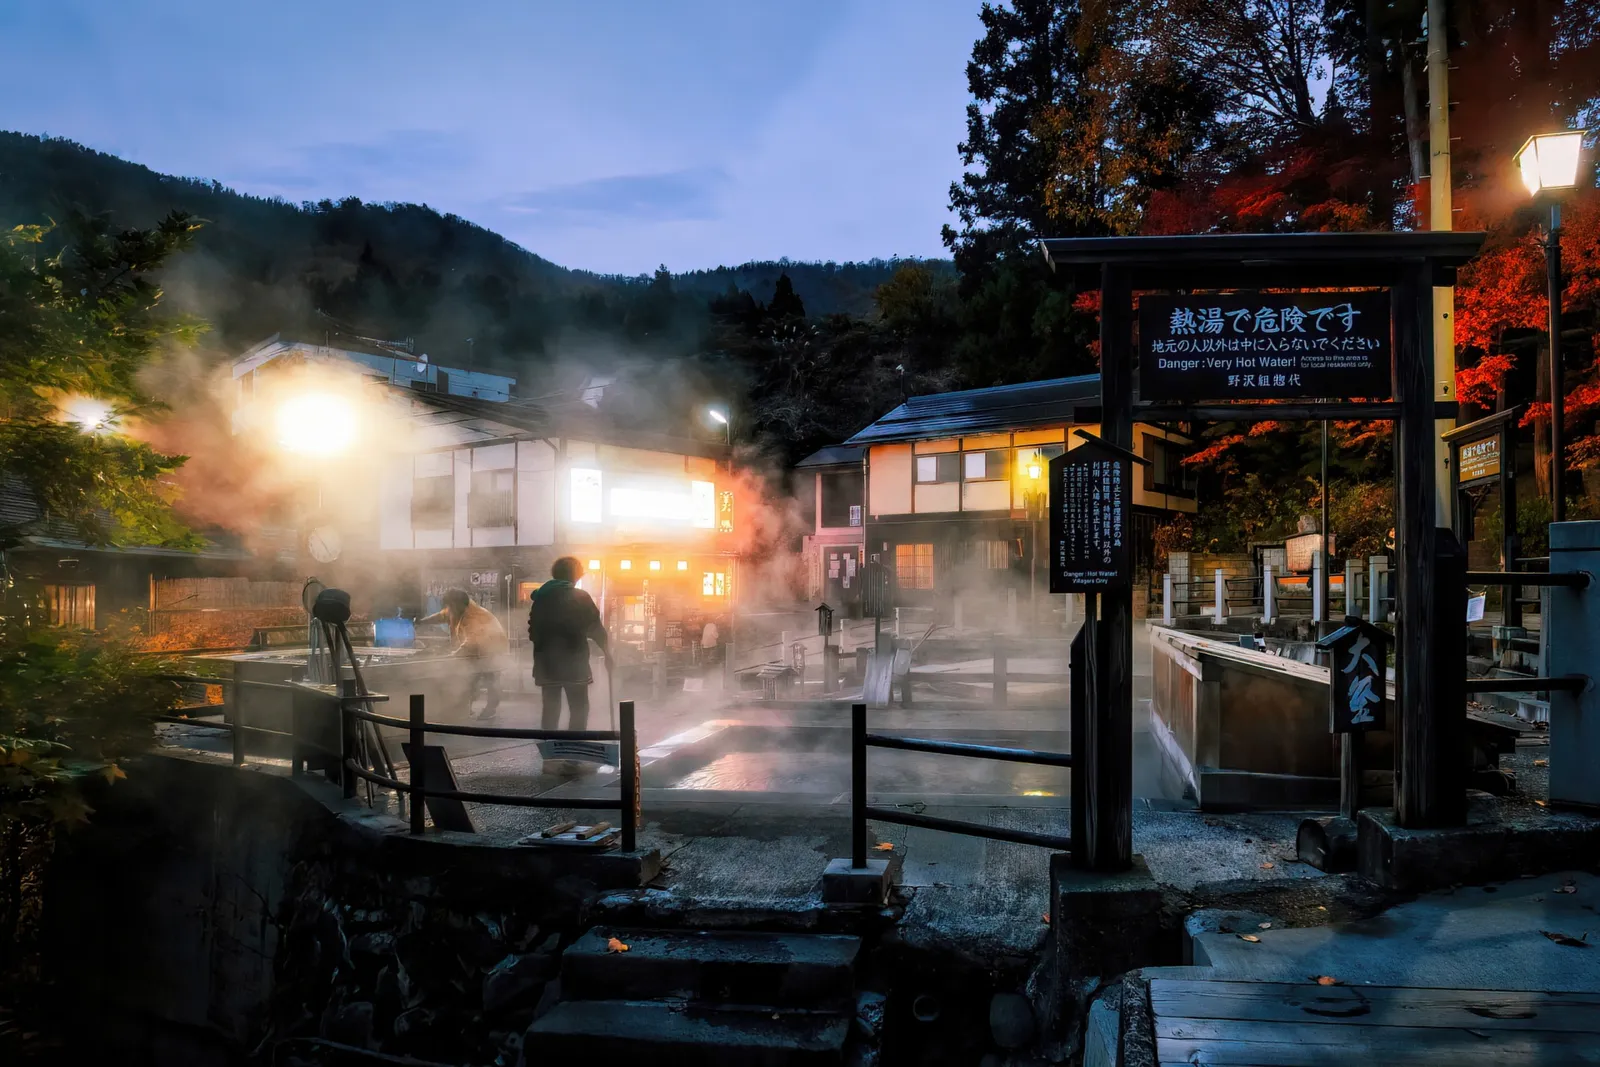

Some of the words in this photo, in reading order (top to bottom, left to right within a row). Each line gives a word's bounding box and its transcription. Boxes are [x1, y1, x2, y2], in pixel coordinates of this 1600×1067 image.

[1170, 303, 1361, 335] 熱湯で危険です
[1152, 336, 1380, 353] 地元の人以外は中に入らないでください
[1159, 358, 1199, 371] Danger
[1236, 357, 1256, 368] Hot
[1259, 356, 1296, 368] Water!
[1228, 374, 1301, 387] 野沢組惣代
